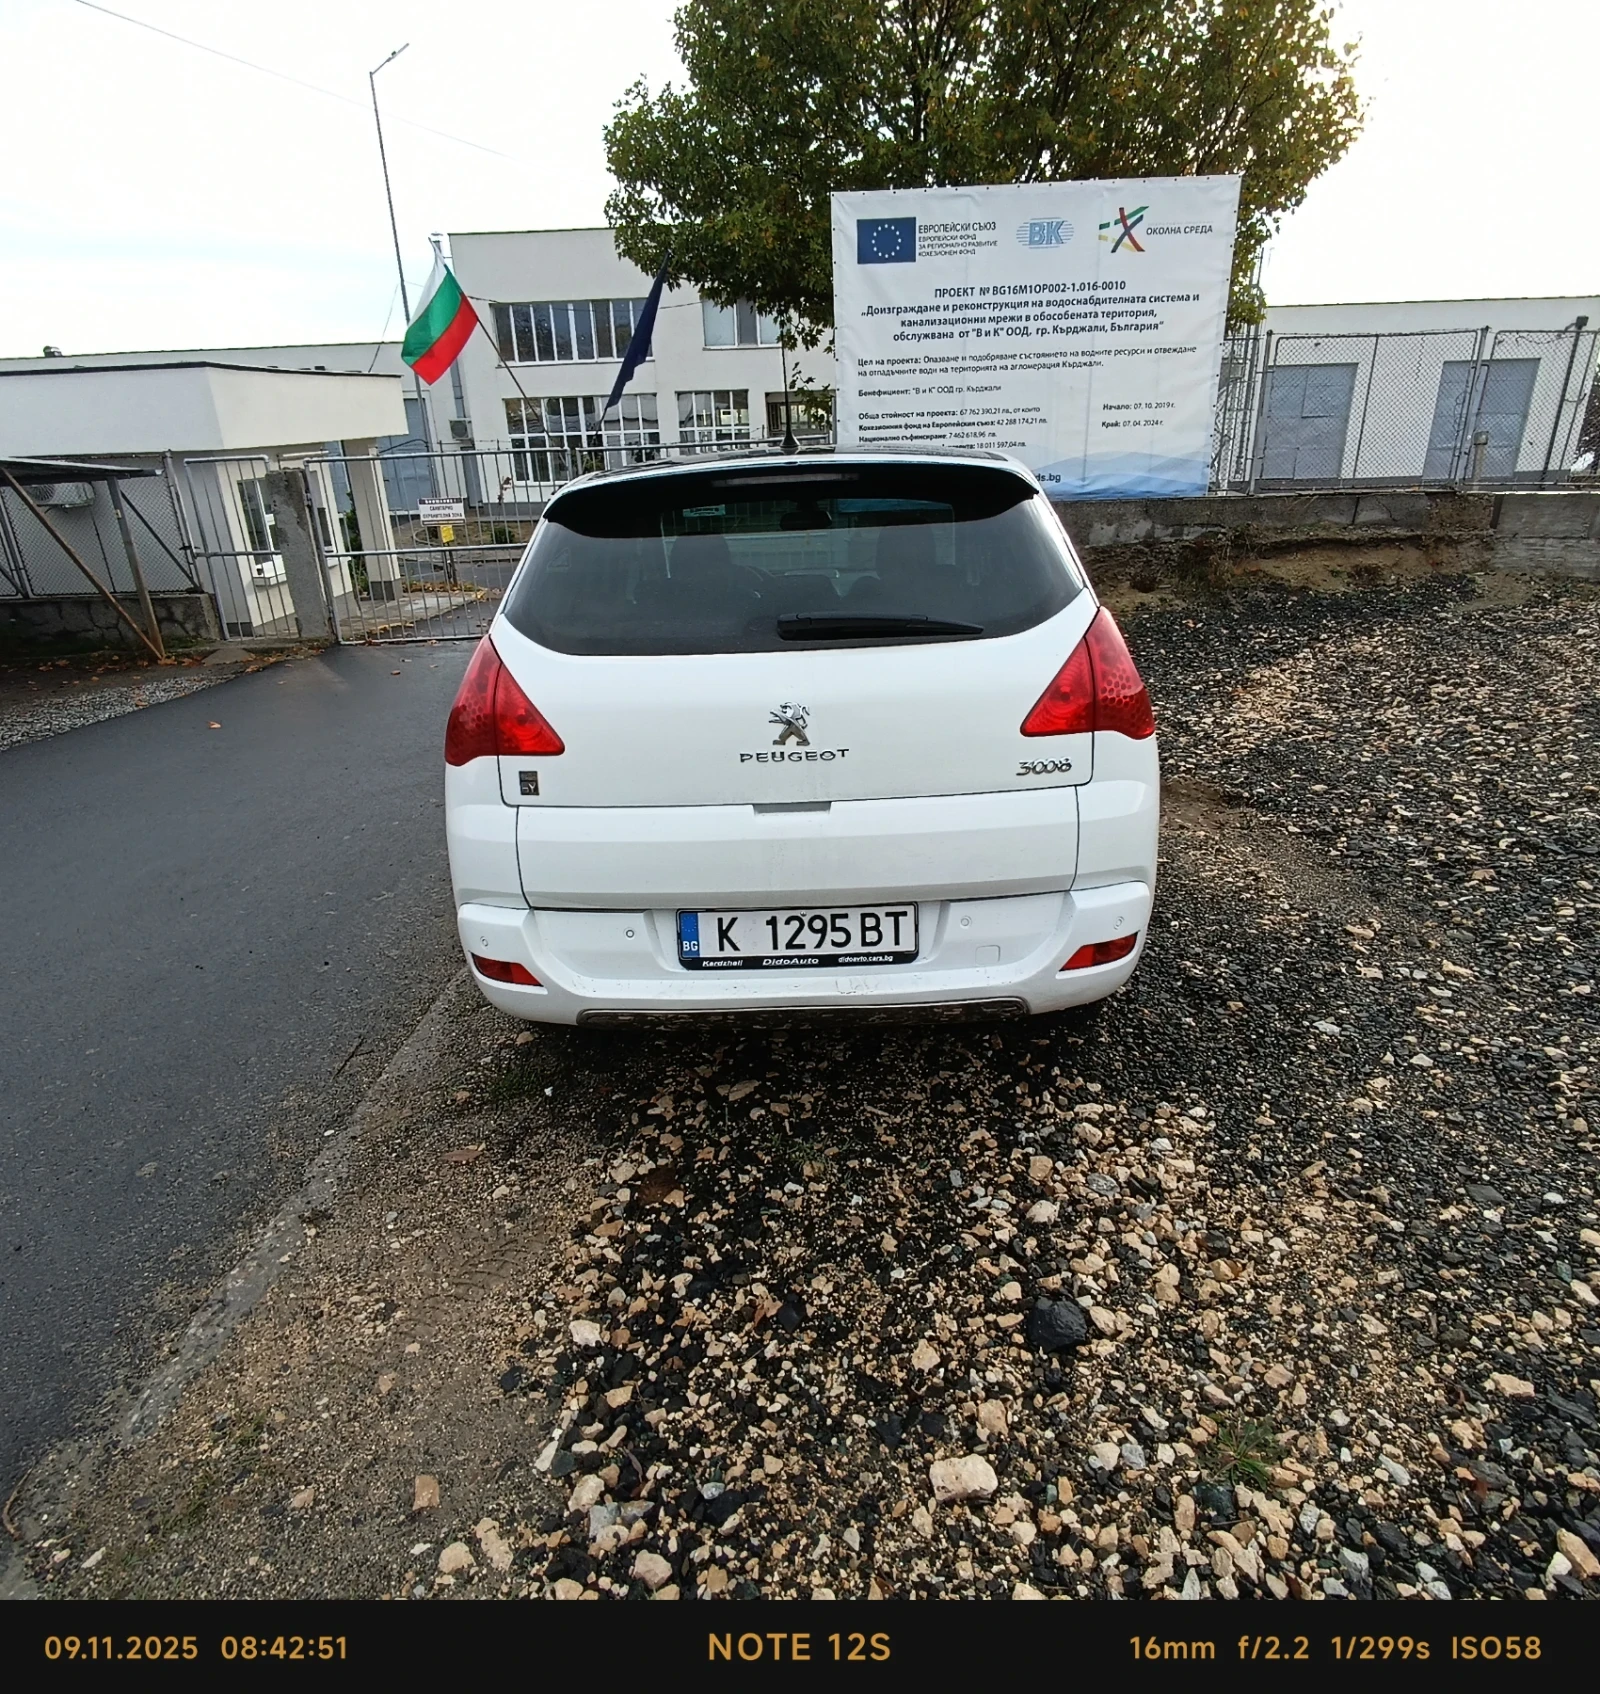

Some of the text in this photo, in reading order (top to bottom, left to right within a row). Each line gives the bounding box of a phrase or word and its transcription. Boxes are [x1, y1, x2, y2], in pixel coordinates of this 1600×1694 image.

[918, 221, 996, 234] ЕВРОПЕЙСКИ СЪЮЗ
[1146, 224, 1213, 236] ОКОЛНА СРЕДА
[927, 241, 968, 249] РЕГИОНАЛНО
[934, 286, 975, 298] ПРОЕКТ
[979, 286, 990, 296] №
[861, 294, 1200, 316] „Доизграждане и реконструкция на водоснабдителната система и
[900, 308, 1157, 328] канализационни мрежи в обособената територия,
[893, 330, 954, 342] обслужвана
[958, 330, 970, 338] от
[972, 328, 983, 338] "В
[993, 327, 1004, 336] К"
[1036, 328, 1050, 337] гр.
[1052, 324, 1108, 336] Кърджали,
[858, 358, 873, 367] Цел
[875, 358, 884, 366] на
[886, 356, 921, 367] проекта:
[924, 356, 960, 364] Опазване
[968, 353, 1018, 362] подобряване
[1019, 352, 1067, 360] състоянието
[1069, 350, 1079, 358] на
[1080, 350, 1112, 358] водните
[1114, 348, 1146, 358] ресурси
[1154, 346, 1197, 354] отвеждане
[869, 368, 916, 377] отпадъчните
[918, 368, 938, 376] води
[940, 366, 948, 374] на
[950, 365, 998, 374] територията
[1010, 362, 1060, 370] агломерация
[1062, 360, 1104, 369] Кърджали.
[858, 387, 911, 398] Бенефициент:
[937, 386, 954, 394] ООД
[956, 386, 966, 394] гр.
[966, 384, 1002, 393] Кърджали
[858, 412, 880, 420] Обща
[880, 411, 914, 419] стойност
[926, 410, 958, 418] проекта:
[960, 408, 968, 416] 67
[968, 408, 980, 416] 762
[904, 422, 922, 430] фонд
[932, 420, 976, 429] Европейския
[976, 420, 996, 428] съюз:
[1102, 420, 1120, 428] Край:
[858, 434, 900, 443] Национално
[739, 748, 850, 763] PEUGEOT
[1016, 757, 1073, 776] 3008
[717, 911, 908, 951] K 1295 BT
[683, 940, 698, 952] BG
[762, 958, 819, 966] DidoAuto
